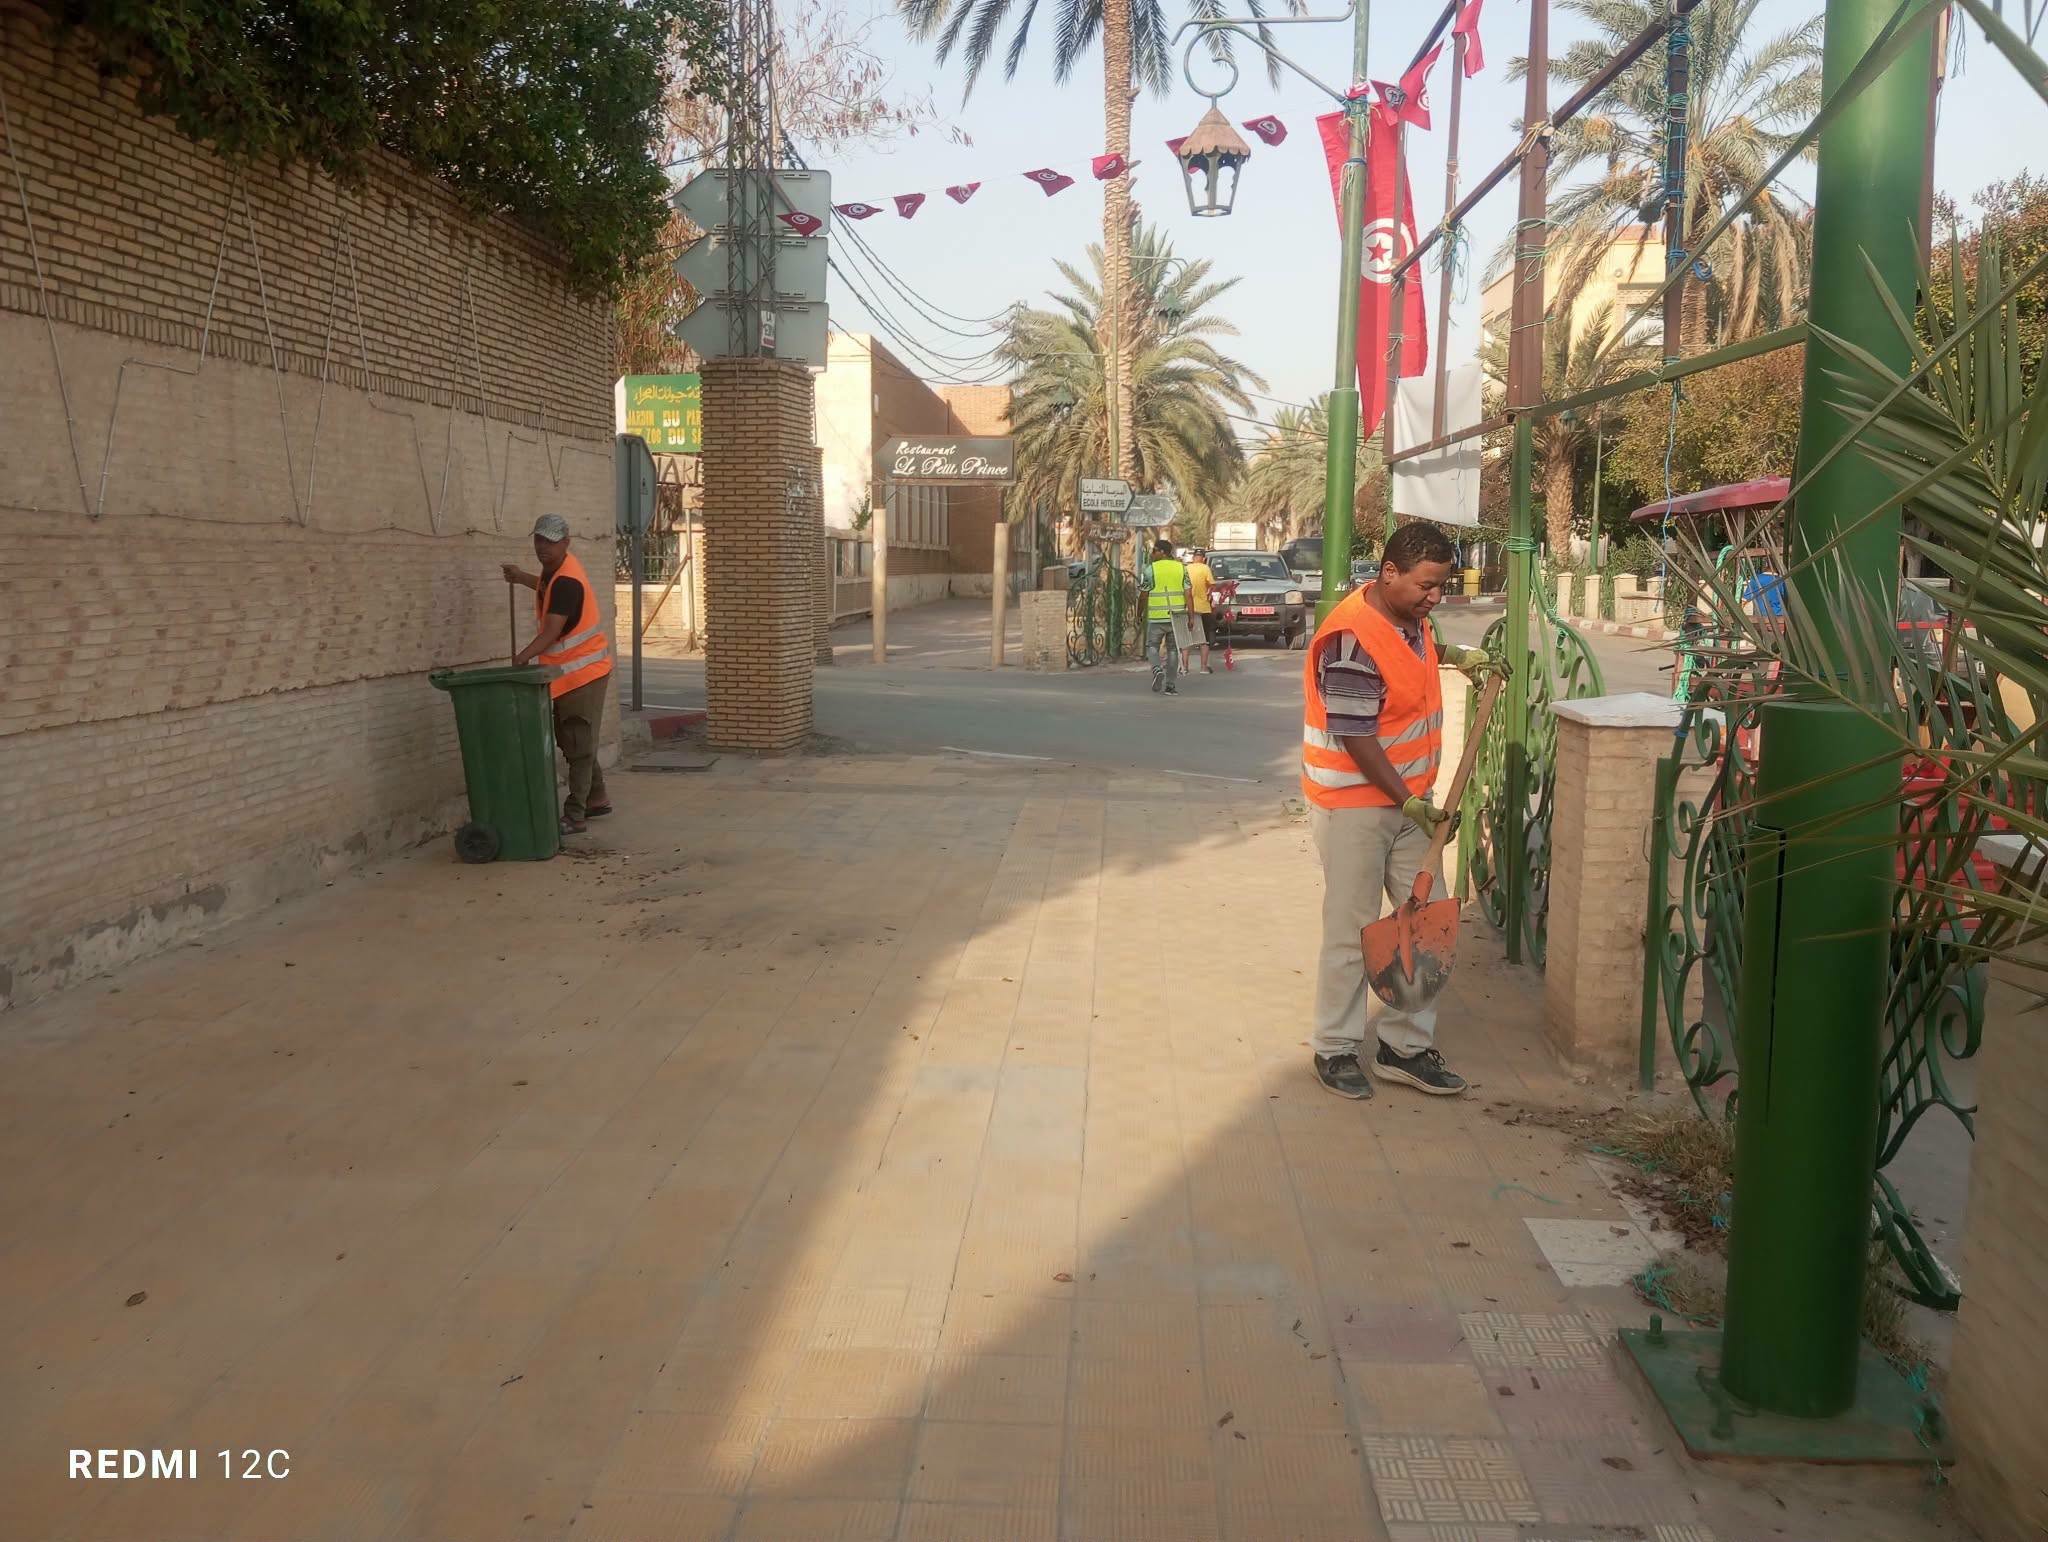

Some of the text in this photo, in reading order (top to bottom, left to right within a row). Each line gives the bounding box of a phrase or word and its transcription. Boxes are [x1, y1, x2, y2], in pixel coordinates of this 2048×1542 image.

[627, 410, 655, 427] JARDIN
[663, 410, 680, 427] DU
[668, 428, 685, 445] DU
[896, 441, 957, 455] Restaurant
[892, 456, 1008, 475] Le Petit Prince
